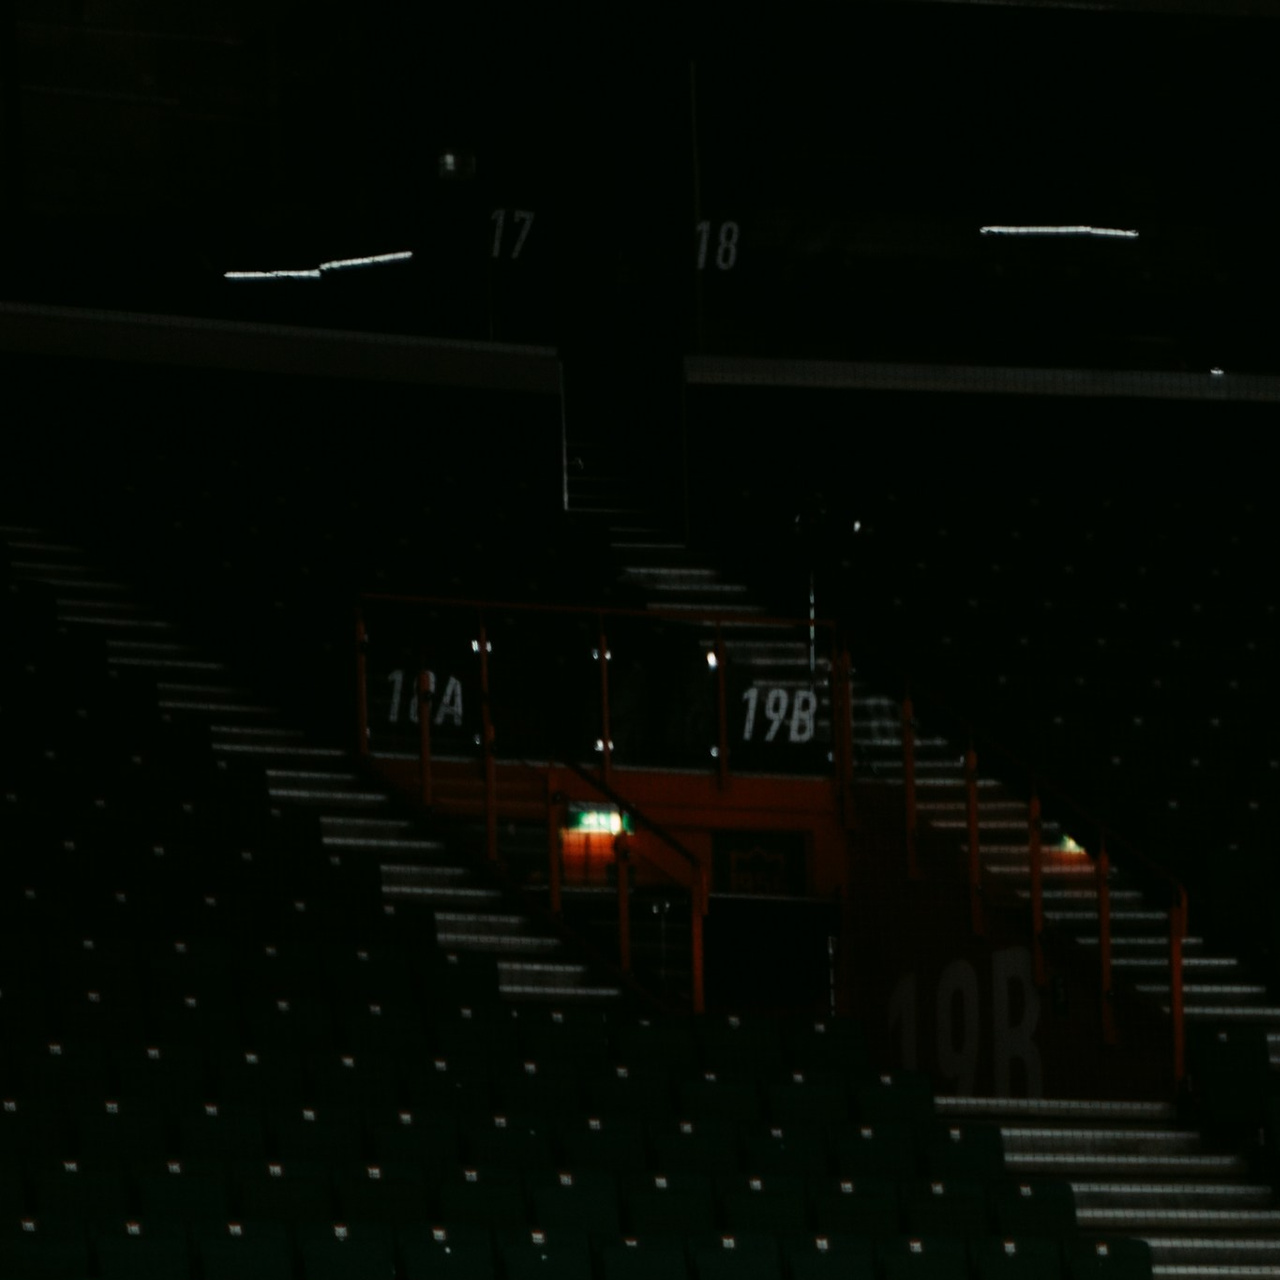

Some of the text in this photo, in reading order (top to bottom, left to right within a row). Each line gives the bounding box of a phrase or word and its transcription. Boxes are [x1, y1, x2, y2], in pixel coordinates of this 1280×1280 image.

[490, 208, 535, 260] 17
[697, 219, 740, 270] 18
[742, 687, 817, 743] 19B
